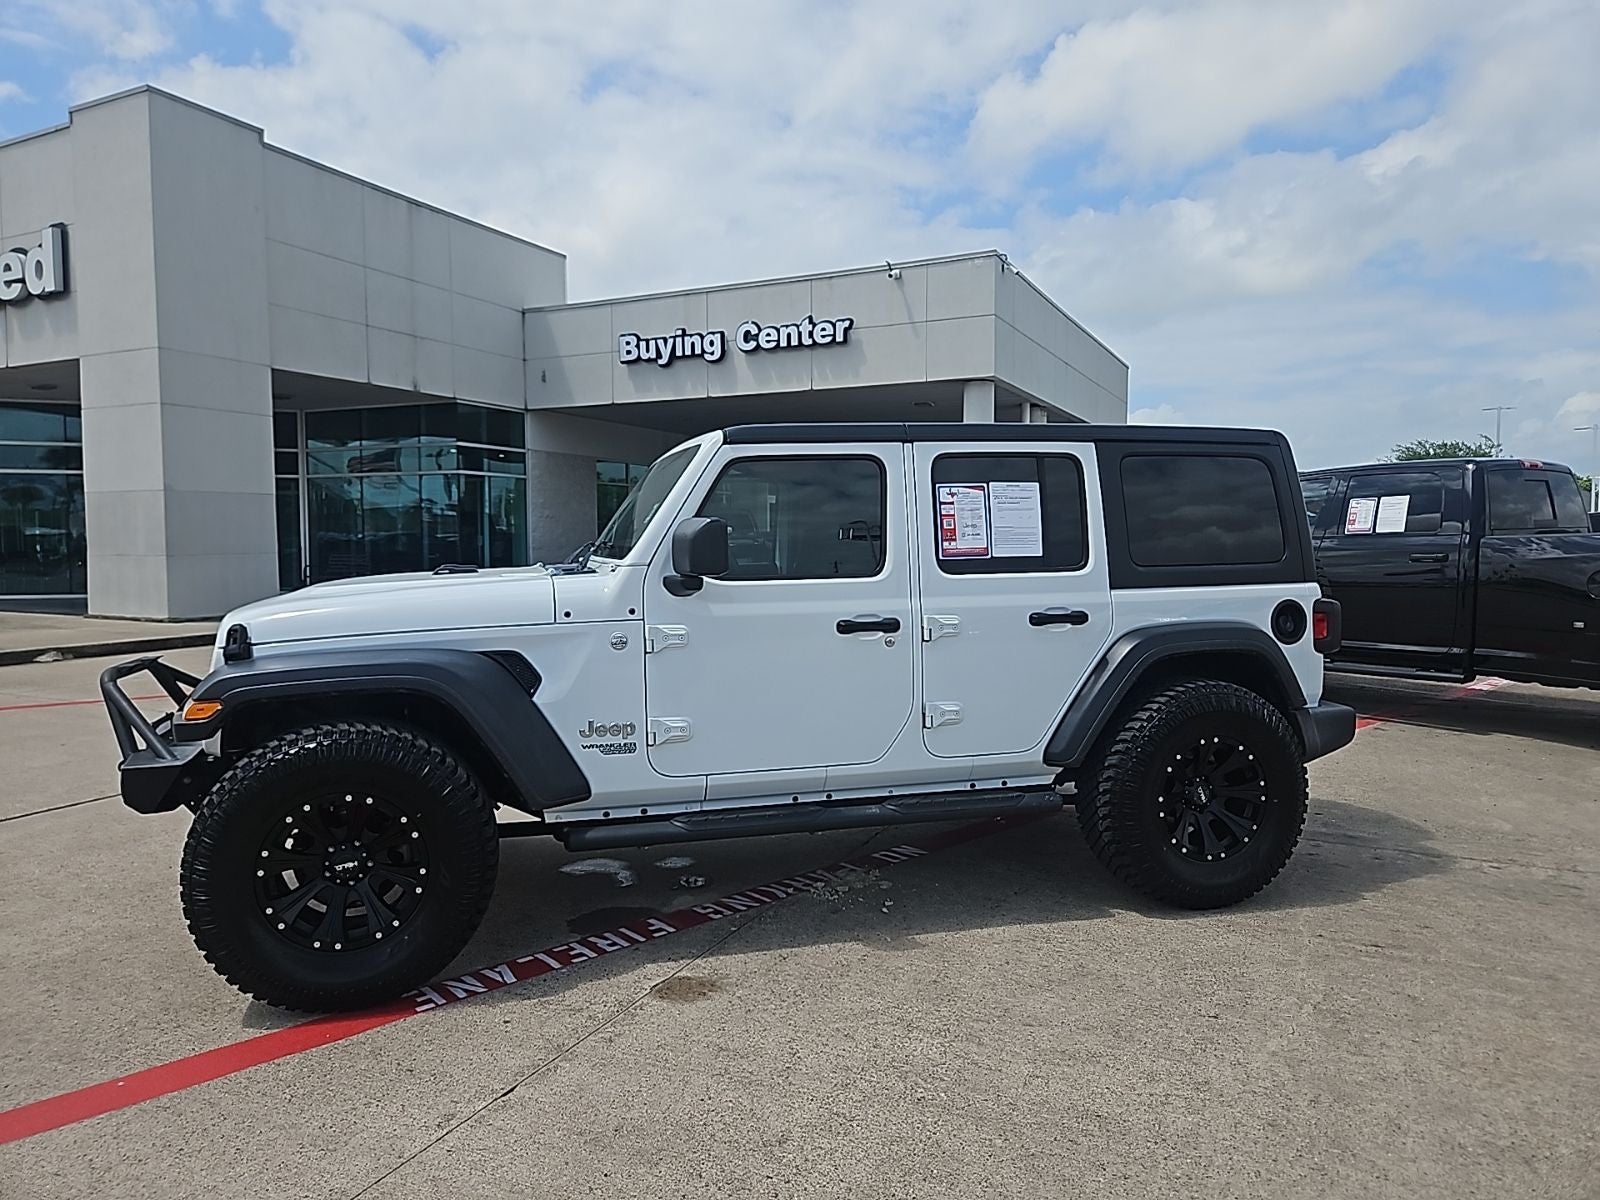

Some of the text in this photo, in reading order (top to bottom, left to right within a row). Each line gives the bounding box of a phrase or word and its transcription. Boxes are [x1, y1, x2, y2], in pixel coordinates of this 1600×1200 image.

[619, 316, 852, 367] Buying Center
[579, 719, 636, 739] Jeep
[581, 742, 637, 750] WRANGLER
[872, 844, 928, 863] NO
